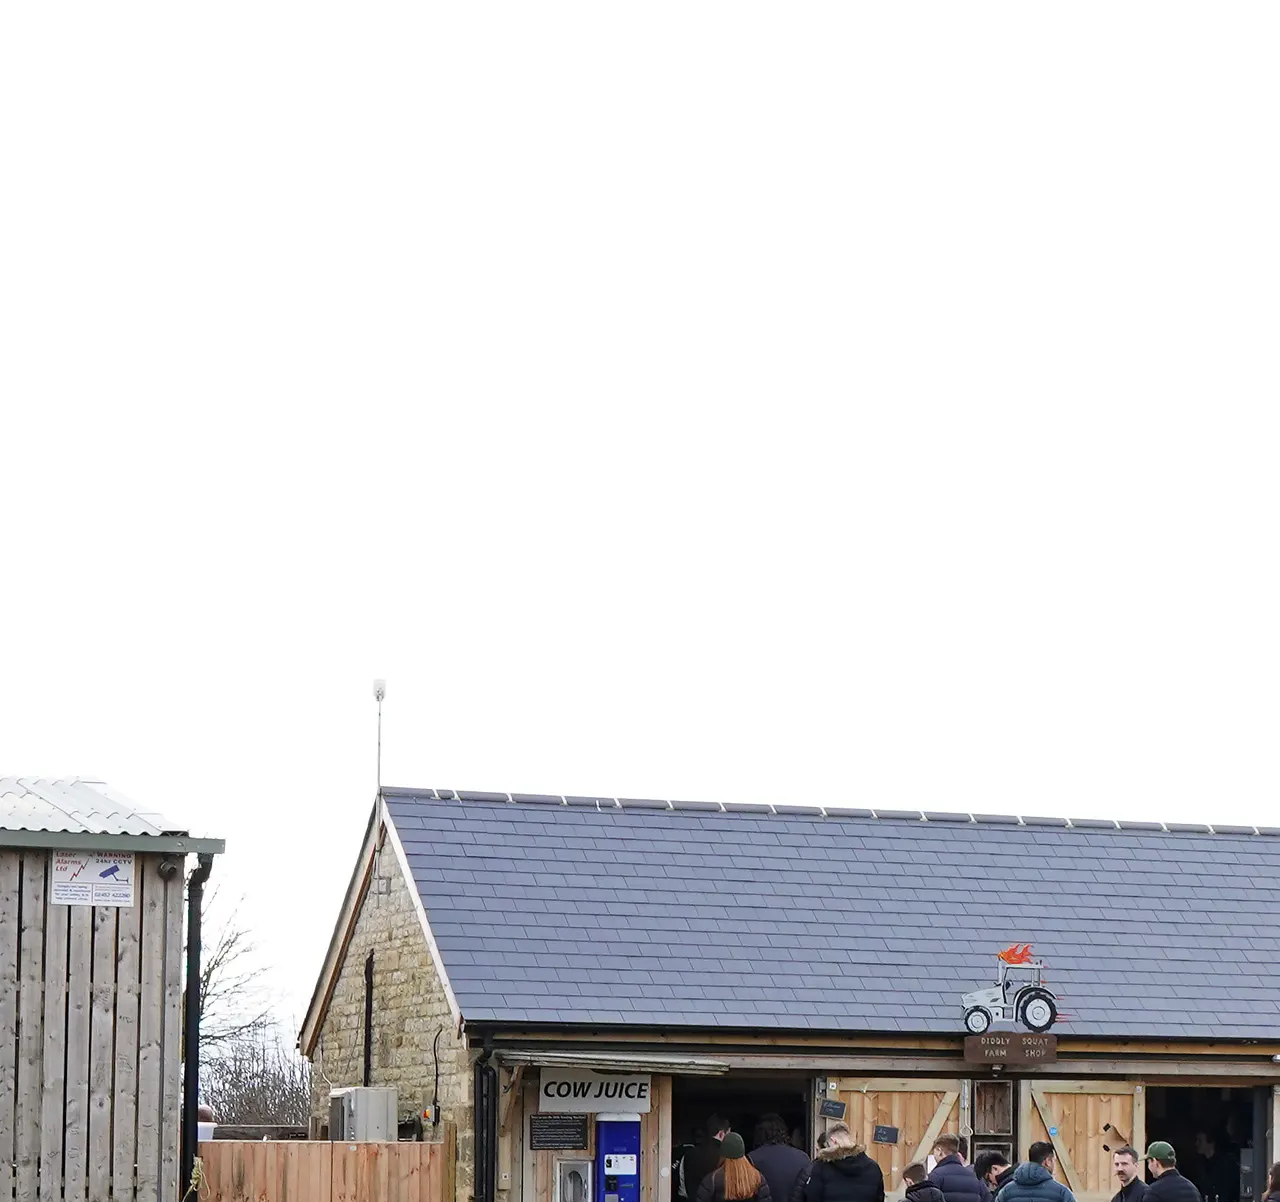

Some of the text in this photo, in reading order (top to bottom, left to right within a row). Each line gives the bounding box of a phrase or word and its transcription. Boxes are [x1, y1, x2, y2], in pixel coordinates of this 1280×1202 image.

[980, 1037, 1049, 1046] DIDDLY SQUAT
[984, 1049, 1047, 1058] FARM SHOP
[543, 1081, 649, 1099] COW JUICE
